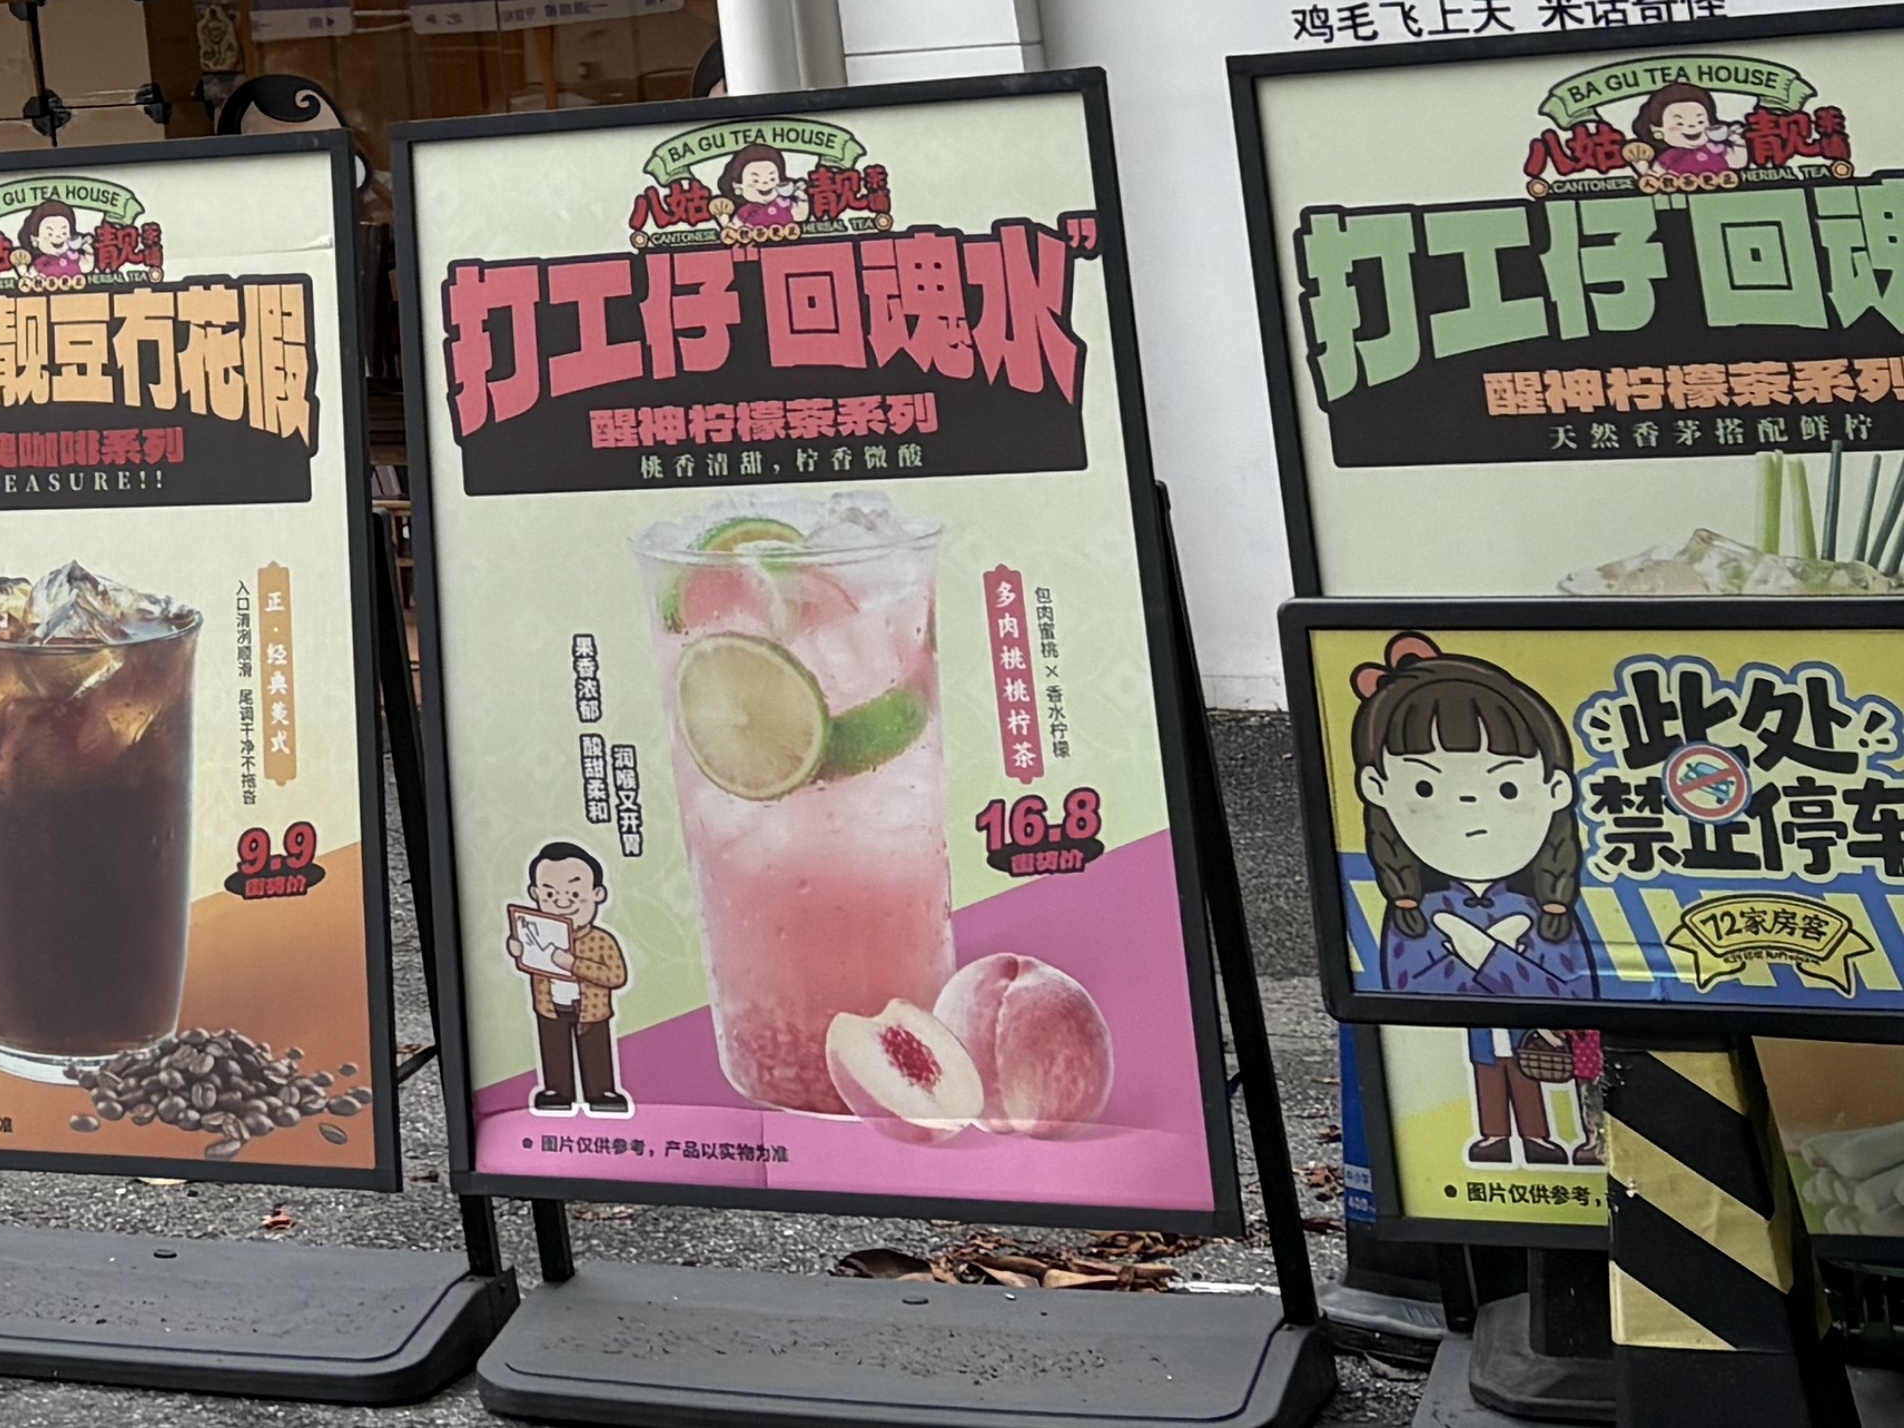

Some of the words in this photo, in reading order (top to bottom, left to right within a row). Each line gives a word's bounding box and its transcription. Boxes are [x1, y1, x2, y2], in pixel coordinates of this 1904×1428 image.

[1567, 82, 1599, 104] BA
[1605, 72, 1639, 91] GU
[1644, 66, 1690, 85] TEA
[1698, 65, 1779, 89] HOUSE
[667, 139, 695, 163] BA
[697, 134, 726, 154] GU
[731, 127, 767, 147] TEA
[772, 127, 838, 151] HOUSE
[1524, 124, 1626, 176] 八姑
[1745, 109, 1821, 166] 靓
[631, 182, 711, 231] 八姑
[807, 168, 868, 219] 靓
[1554, 177, 1634, 193] CANTONESE
[1742, 167, 1794, 182] HERBAL
[1801, 164, 1830, 178] TEA
[1484, 358, 1904, 416] 醒神柠檬茶系列
[590, 392, 938, 448] 醒神柠檬茶系列
[1549, 414, 1874, 450] 天然香茅搭配鲜柠
[640, 444, 923, 480] 桃香清甜，柠香微酸
[572, 634, 602, 722] 果香浓郁
[995, 581, 1036, 769] 多肉桃桃柠茶
[1045, 685, 1071, 758] 香水柠檬
[1618, 670, 1859, 774] 此处
[579, 733, 611, 823] 酸甜柔和
[611, 744, 642, 857] 润喉又开胃
[237, 821, 317, 876] 9.9
[976, 788, 1100, 852] 16.8
[1591, 775, 1904, 876] 禁止停车
[1700, 906, 1829, 943] 72家房客
[541, 1133, 789, 1166] 图片仅供参考，产品以实物为准
